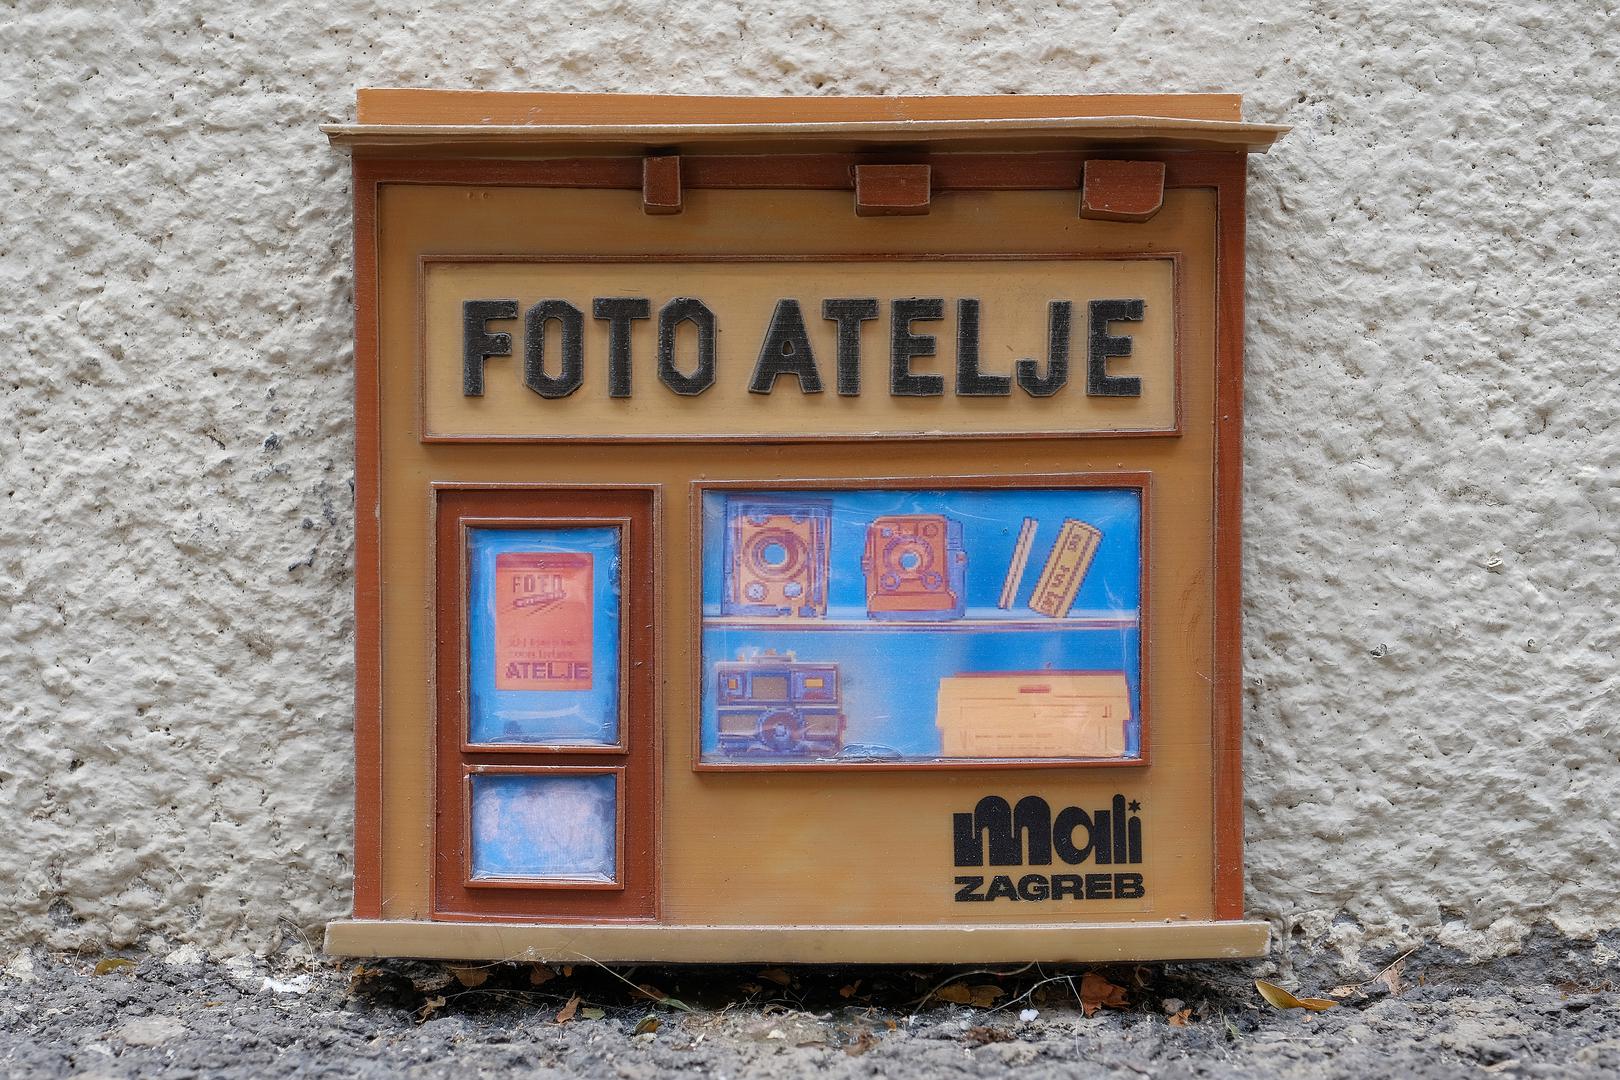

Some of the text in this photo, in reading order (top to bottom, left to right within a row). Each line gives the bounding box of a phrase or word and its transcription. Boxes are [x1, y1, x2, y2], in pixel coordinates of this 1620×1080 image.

[462, 297, 1145, 398] FOTO ATELJE
[512, 574, 564, 593] FOTO
[505, 662, 590, 680] ATELJE
[953, 793, 1143, 867] mali
[954, 873, 1145, 902] ZAGREB
